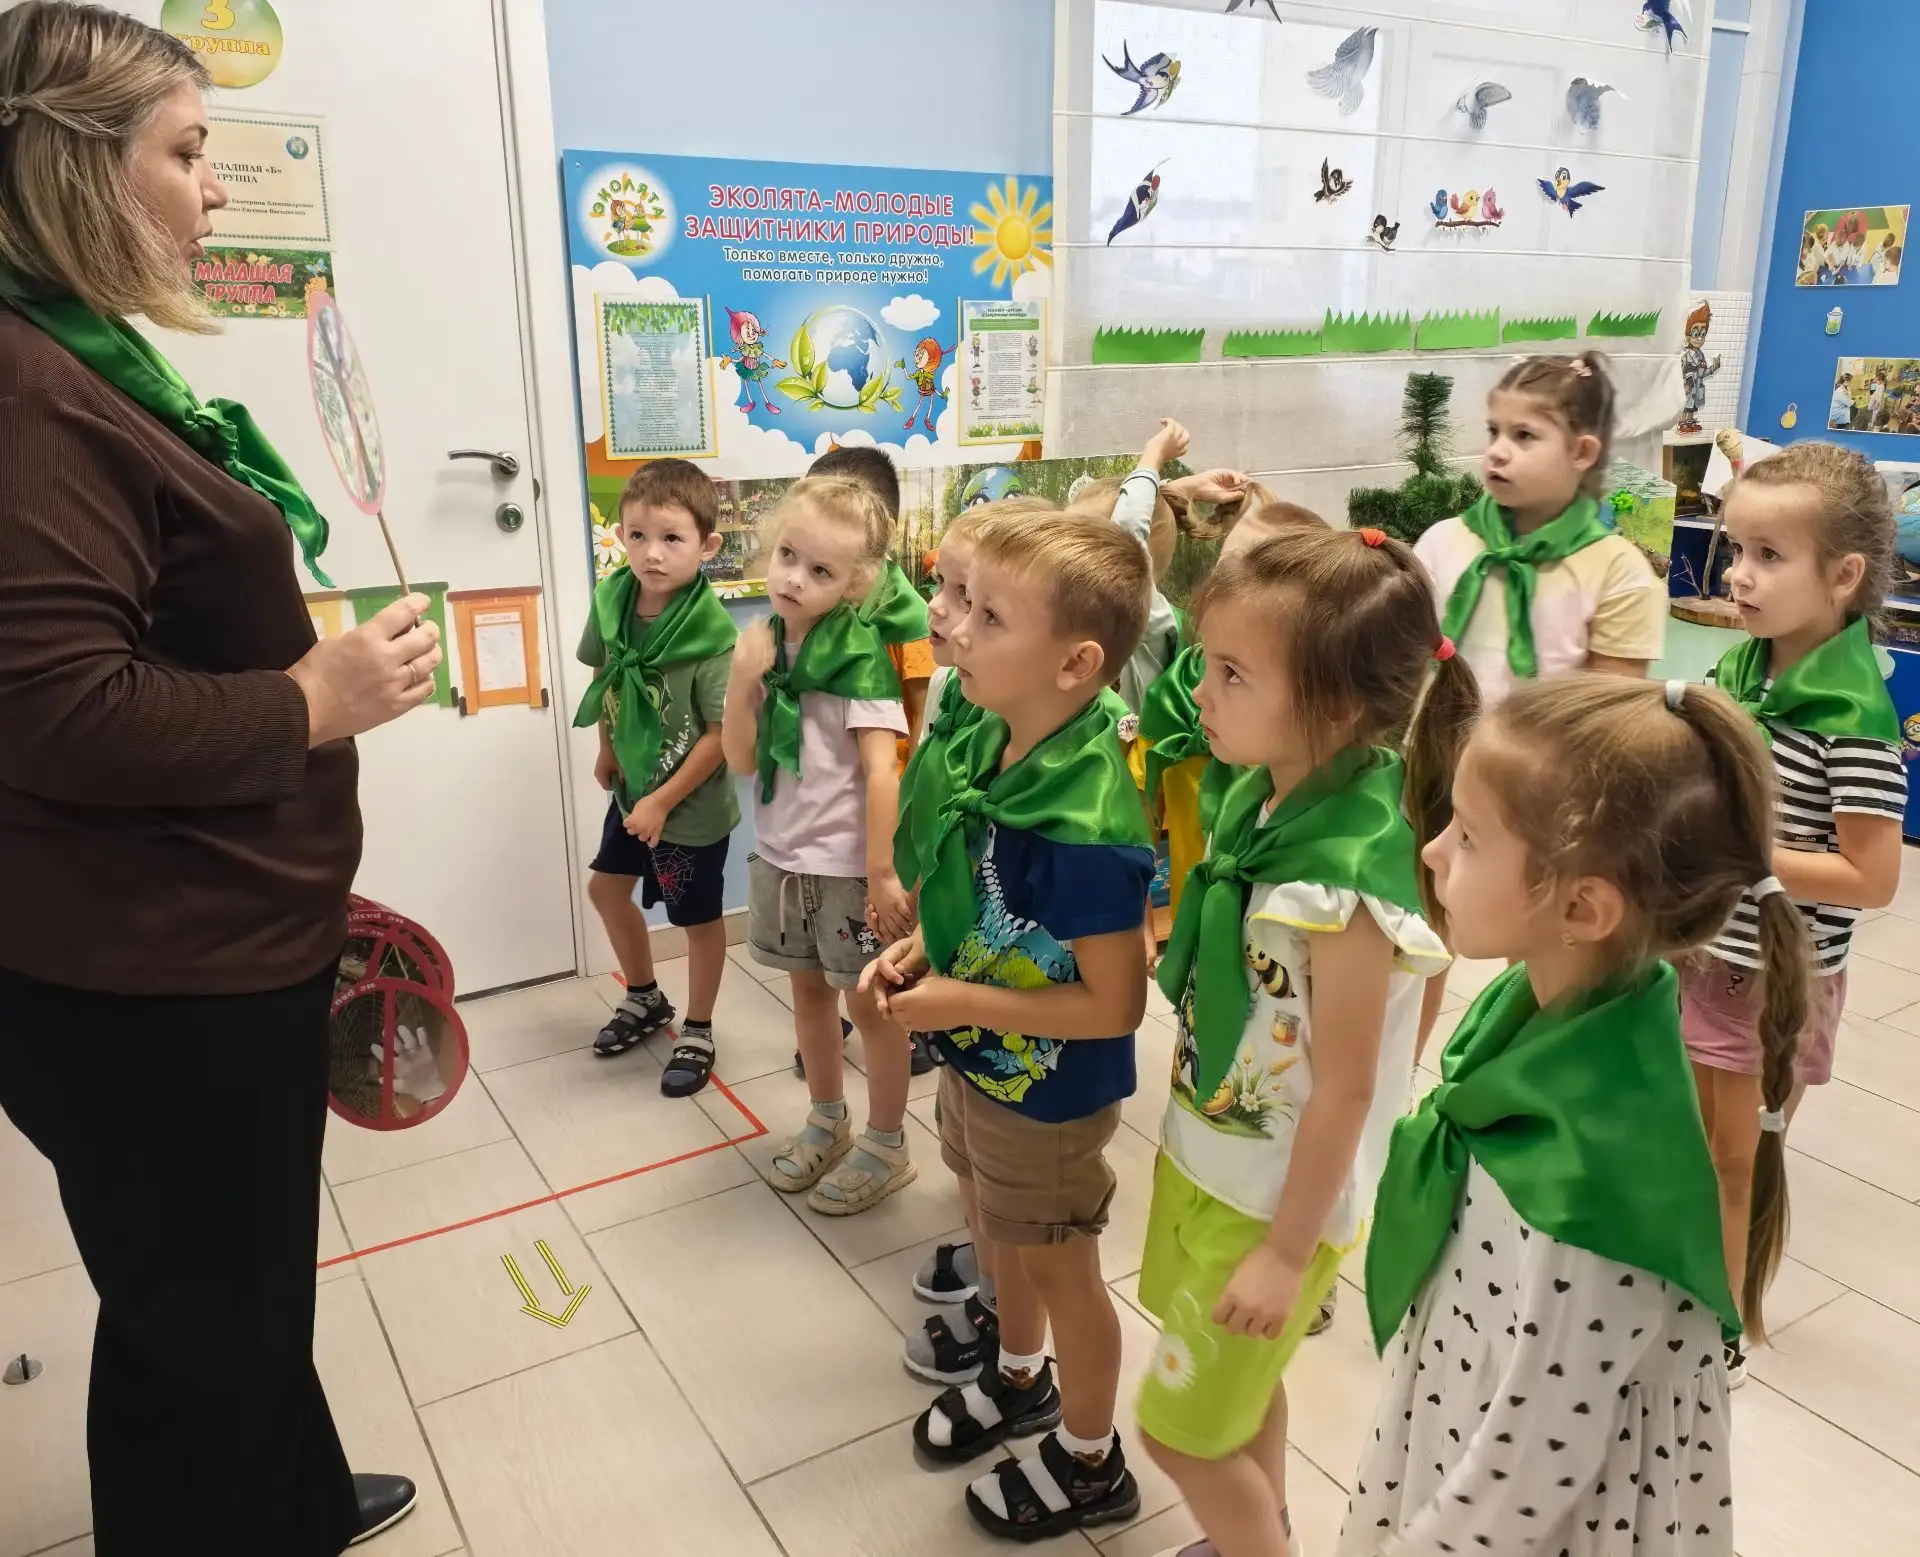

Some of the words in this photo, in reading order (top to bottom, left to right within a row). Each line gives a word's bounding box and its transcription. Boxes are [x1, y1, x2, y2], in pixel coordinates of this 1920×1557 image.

[201, 0, 235, 30] 3
[216, 173, 258, 183] ГРУППА
[592, 178, 665, 216] ЭКОЛЯТА
[709, 184, 954, 218] ЭКОЛЯТА-МОЛОДЫЕ
[684, 215, 846, 242] ЗАЩИТНИКИ
[855, 220, 975, 248] ПРИРОДЫ!
[724, 247, 774, 262] Только
[779, 250, 835, 265] вместе,
[838, 252, 886, 265] только
[889, 253, 945, 268] дружно,
[194, 262, 294, 283] МЛАДШАЯ
[743, 268, 812, 281] помогать
[816, 270, 877, 285] природе
[881, 269, 929, 286] нужно!
[204, 283, 277, 305] ГРУППА
